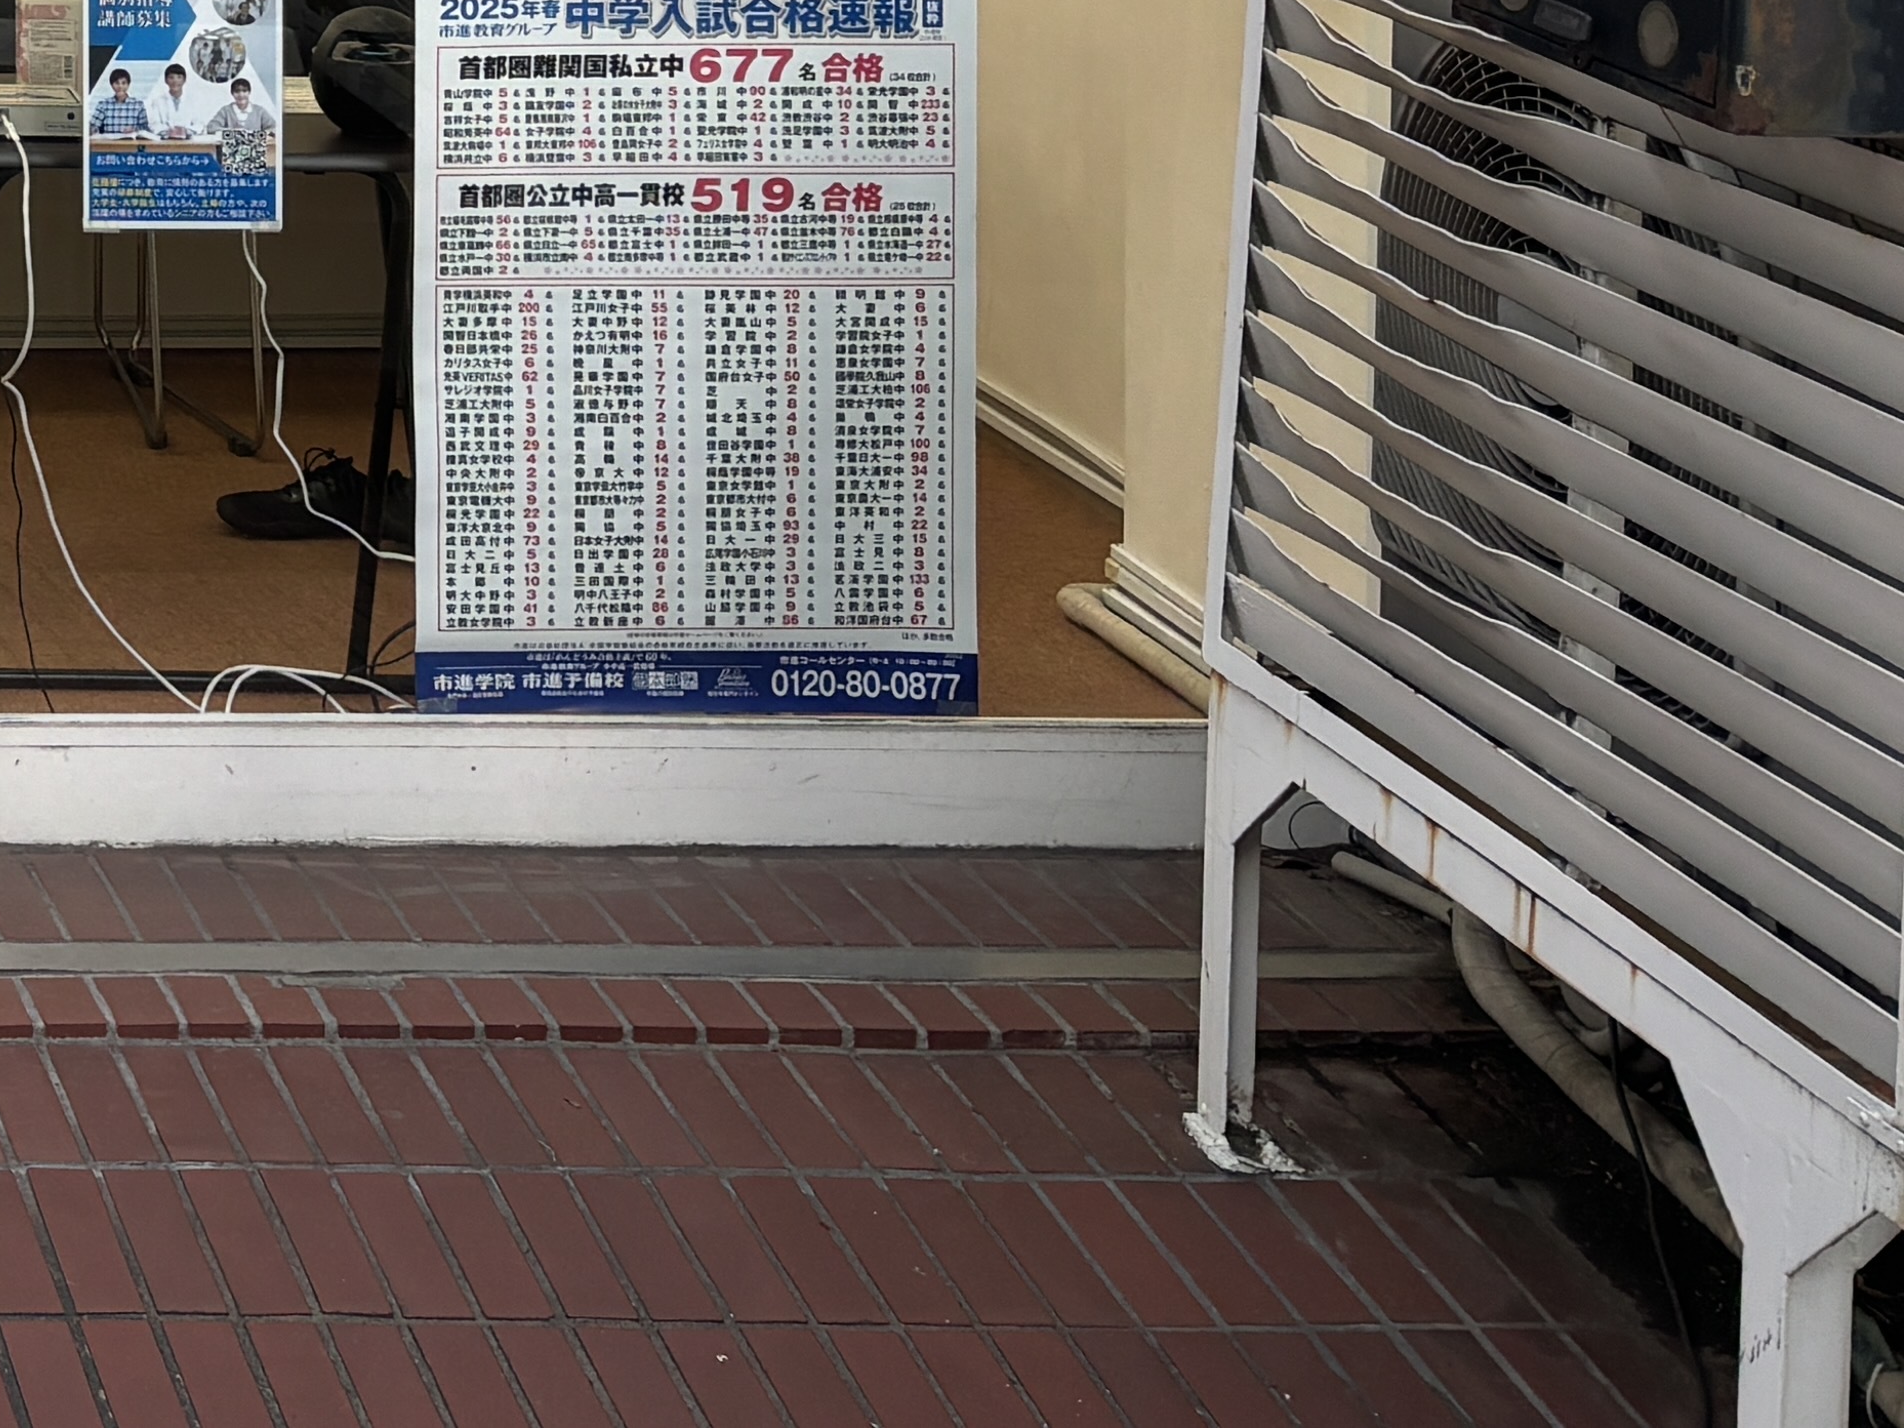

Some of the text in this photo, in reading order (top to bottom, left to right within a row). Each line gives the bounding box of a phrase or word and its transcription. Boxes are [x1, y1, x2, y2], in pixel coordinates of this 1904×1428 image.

[98, 9, 172, 28] 講師募集
[771, 669, 961, 701] 0120-80-0877
